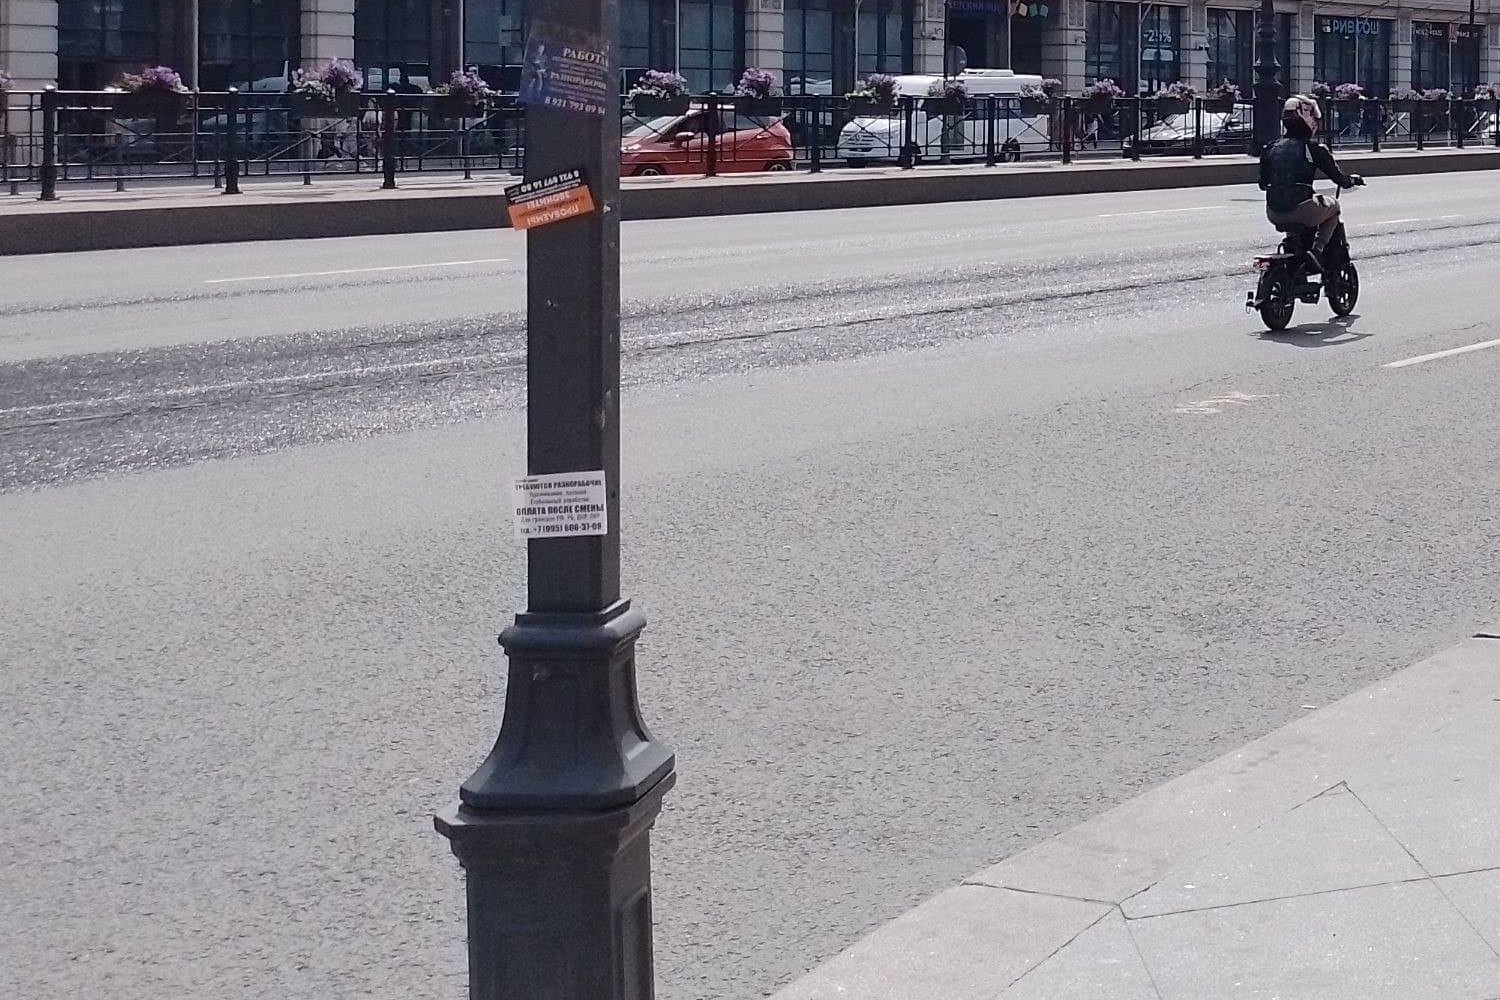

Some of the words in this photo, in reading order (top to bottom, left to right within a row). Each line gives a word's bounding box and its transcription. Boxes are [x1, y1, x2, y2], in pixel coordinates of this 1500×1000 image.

[527, 204, 579, 225] ПРОБЛЕМЫ
[516, 507, 546, 516] ОПЛАТА
[548, 505, 573, 514] ПОСЛЕ
[574, 503, 604, 513] СМЕНЫ
